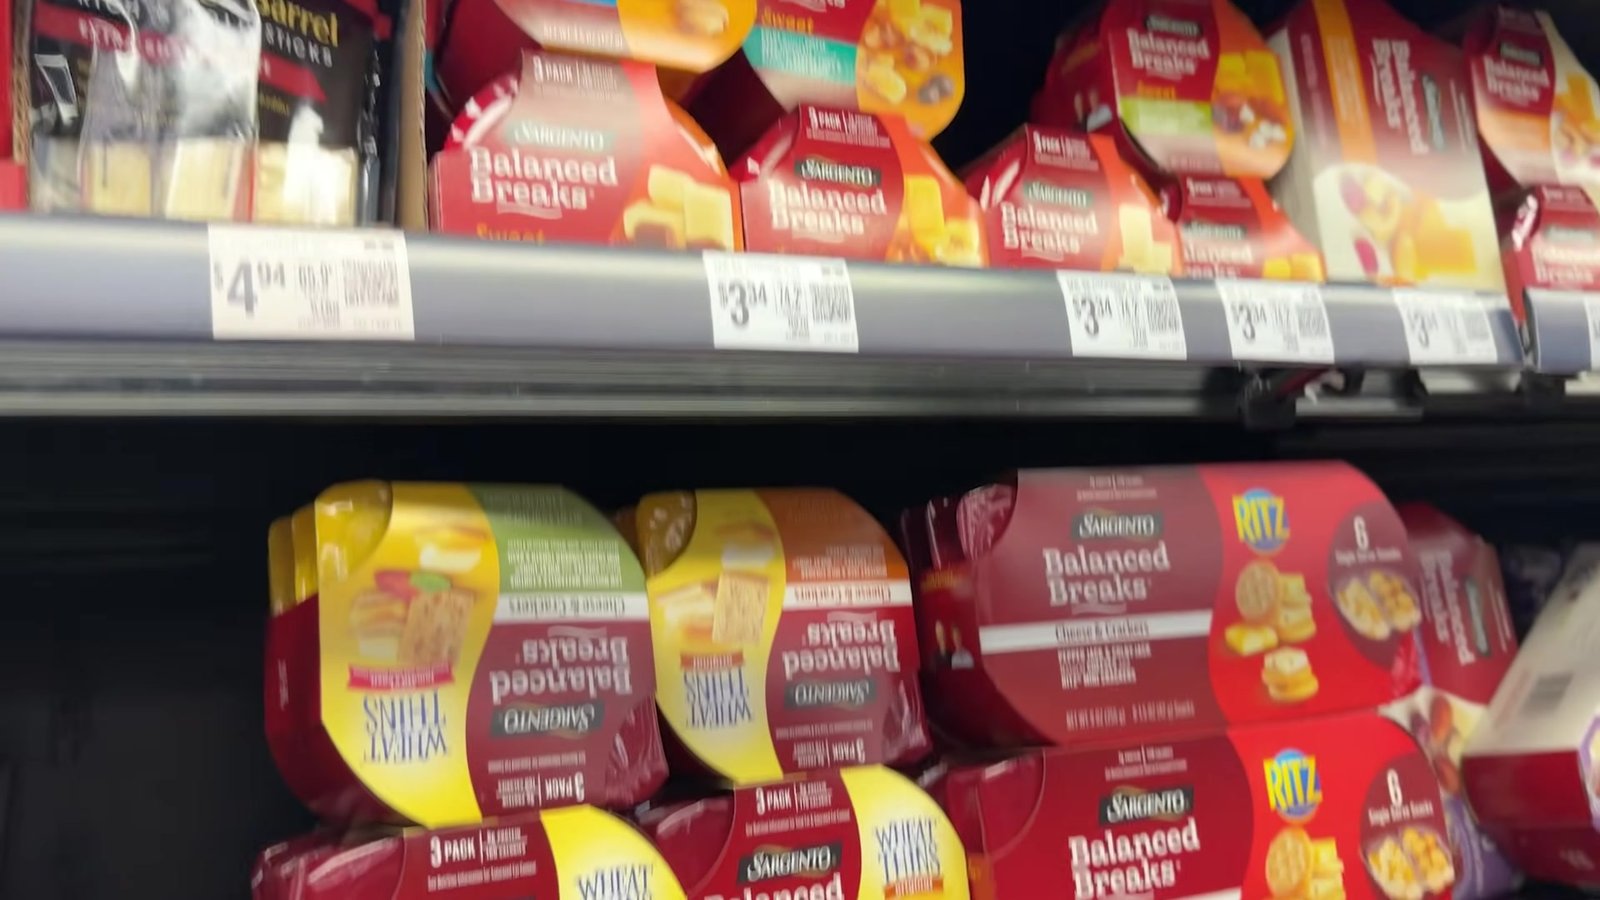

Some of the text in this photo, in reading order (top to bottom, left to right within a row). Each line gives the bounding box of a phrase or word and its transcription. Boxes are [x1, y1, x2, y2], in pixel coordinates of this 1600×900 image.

[264, 22, 333, 68] STICKS
[1127, 28, 1209, 60] Balanced
[470, 149, 618, 186] Balanced
[800, 159, 873, 187] SARGENTO
[472, 178, 588, 211] Breaks
[768, 179, 887, 216] Balanced
[771, 205, 865, 235] Breaks
[1001, 202, 1098, 235] Balanced
[1003, 224, 1081, 255] Breaks
[1079, 513, 1156, 539] SARGENTO
[1232, 494, 1290, 544] RITZ
[1354, 515, 1369, 550] 6
[1043, 540, 1171, 577] Balanced
[508, 596, 567, 616] Crackers
[583, 596, 626, 616] Cheese
[1047, 574, 1148, 607] Breaks
[806, 619, 897, 650] Breaks
[522, 636, 629, 670] Breaks
[782, 644, 900, 681] Balanced
[490, 664, 633, 706] Balanced
[795, 681, 870, 706] SARGENTO
[363, 690, 446, 734] THINS
[504, 704, 596, 735] SARGENTO
[364, 727, 449, 765] WHEAT
[545, 776, 573, 800] PACK
[766, 788, 792, 812] PACK
[1263, 755, 1323, 812] RITZ
[1386, 768, 1403, 807] 6
[1106, 788, 1185, 823] SARGENTO
[444, 837, 476, 863] PACK
[874, 818, 937, 853] WHEAT
[1068, 816, 1200, 868] Balanced
[747, 845, 831, 883] SARGENTO
[878, 841, 941, 883] THINS
[1072, 857, 1176, 900] Breaks
